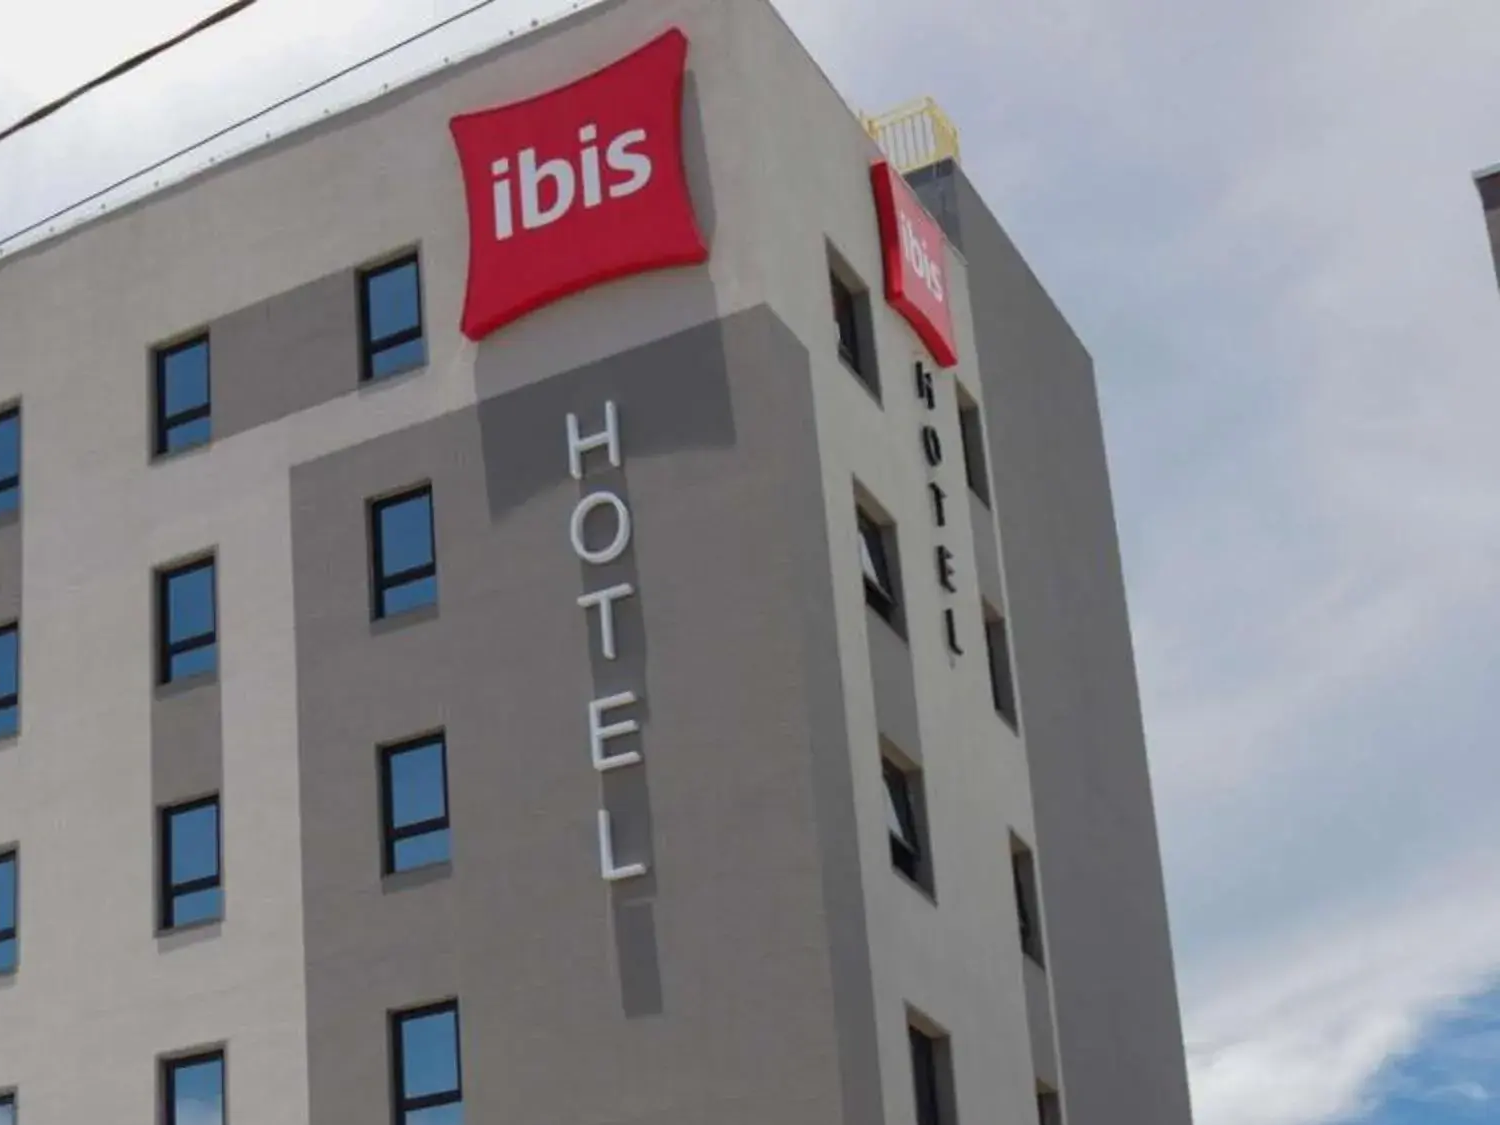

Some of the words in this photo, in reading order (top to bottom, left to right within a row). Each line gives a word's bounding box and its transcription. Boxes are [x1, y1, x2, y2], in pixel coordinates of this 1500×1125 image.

[490, 123, 653, 241] ibis
[899, 214, 944, 303] ibis
[565, 399, 647, 881] HOTEL
